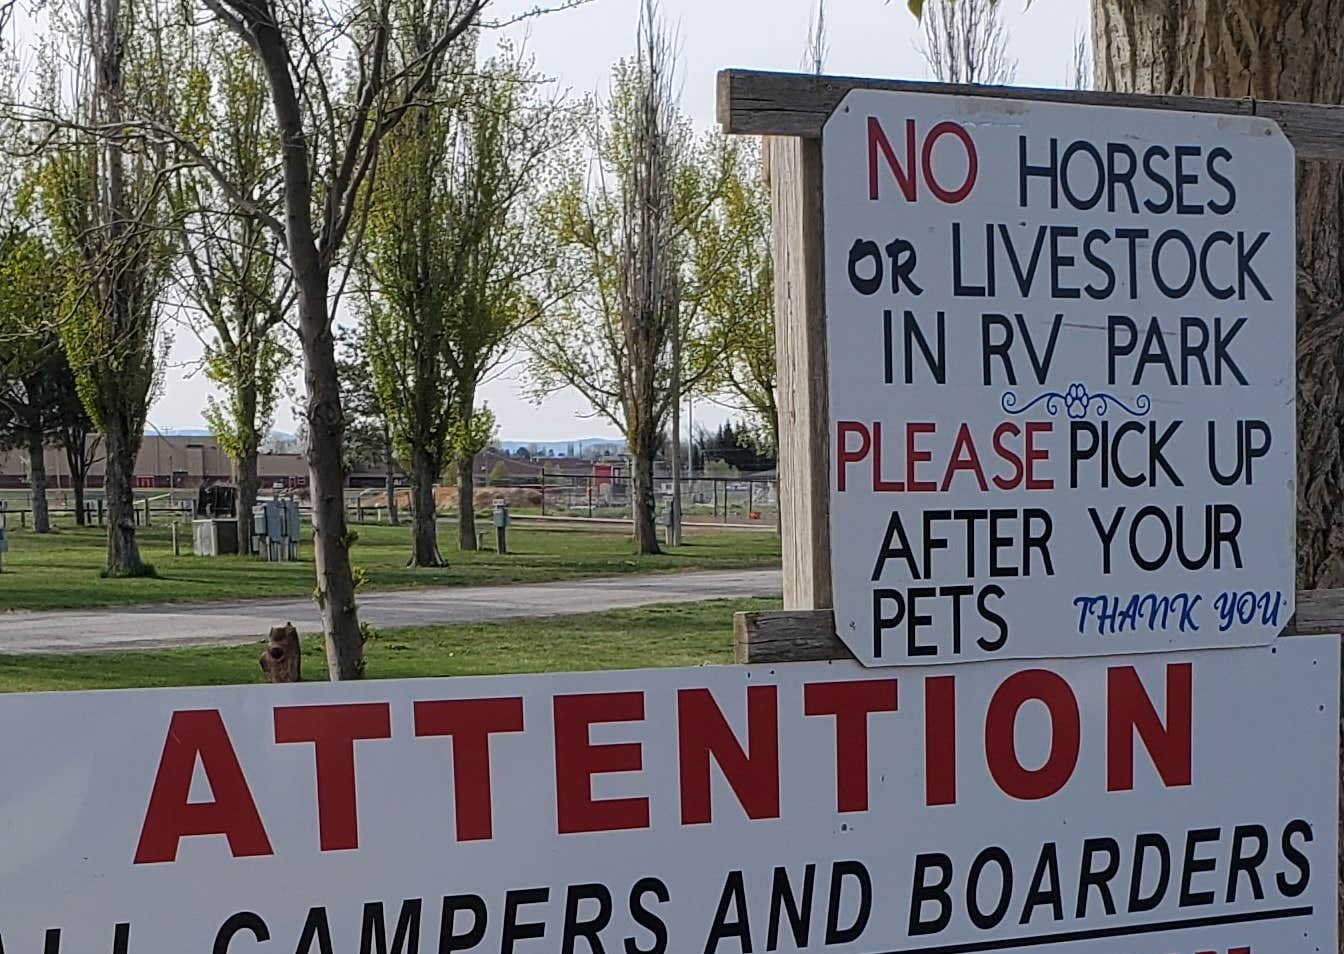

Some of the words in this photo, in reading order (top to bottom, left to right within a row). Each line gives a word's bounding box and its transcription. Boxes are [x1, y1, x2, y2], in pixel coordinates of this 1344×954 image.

[868, 117, 977, 203] NO
[1019, 136, 1236, 215] HORSES
[848, 238, 923, 295] OR
[952, 223, 1272, 300] LIVESTOCK
[884, 310, 945, 384] IN
[982, 314, 1063, 385] RV
[1108, 316, 1249, 385] PARK
[838, 421, 1054, 492] PLEASE
[1071, 421, 1184, 488] PICK
[1208, 420, 1271, 485] UP
[871, 509, 1054, 581] AFTER
[1088, 504, 1242, 574] YOUR
[873, 585, 1008, 658] PETS
[1073, 593, 1202, 635] THANK
[1214, 591, 1283, 631] YOU
[133, 662, 1193, 864] ATTENTION
[908, 820, 1314, 937] BOARDERS
